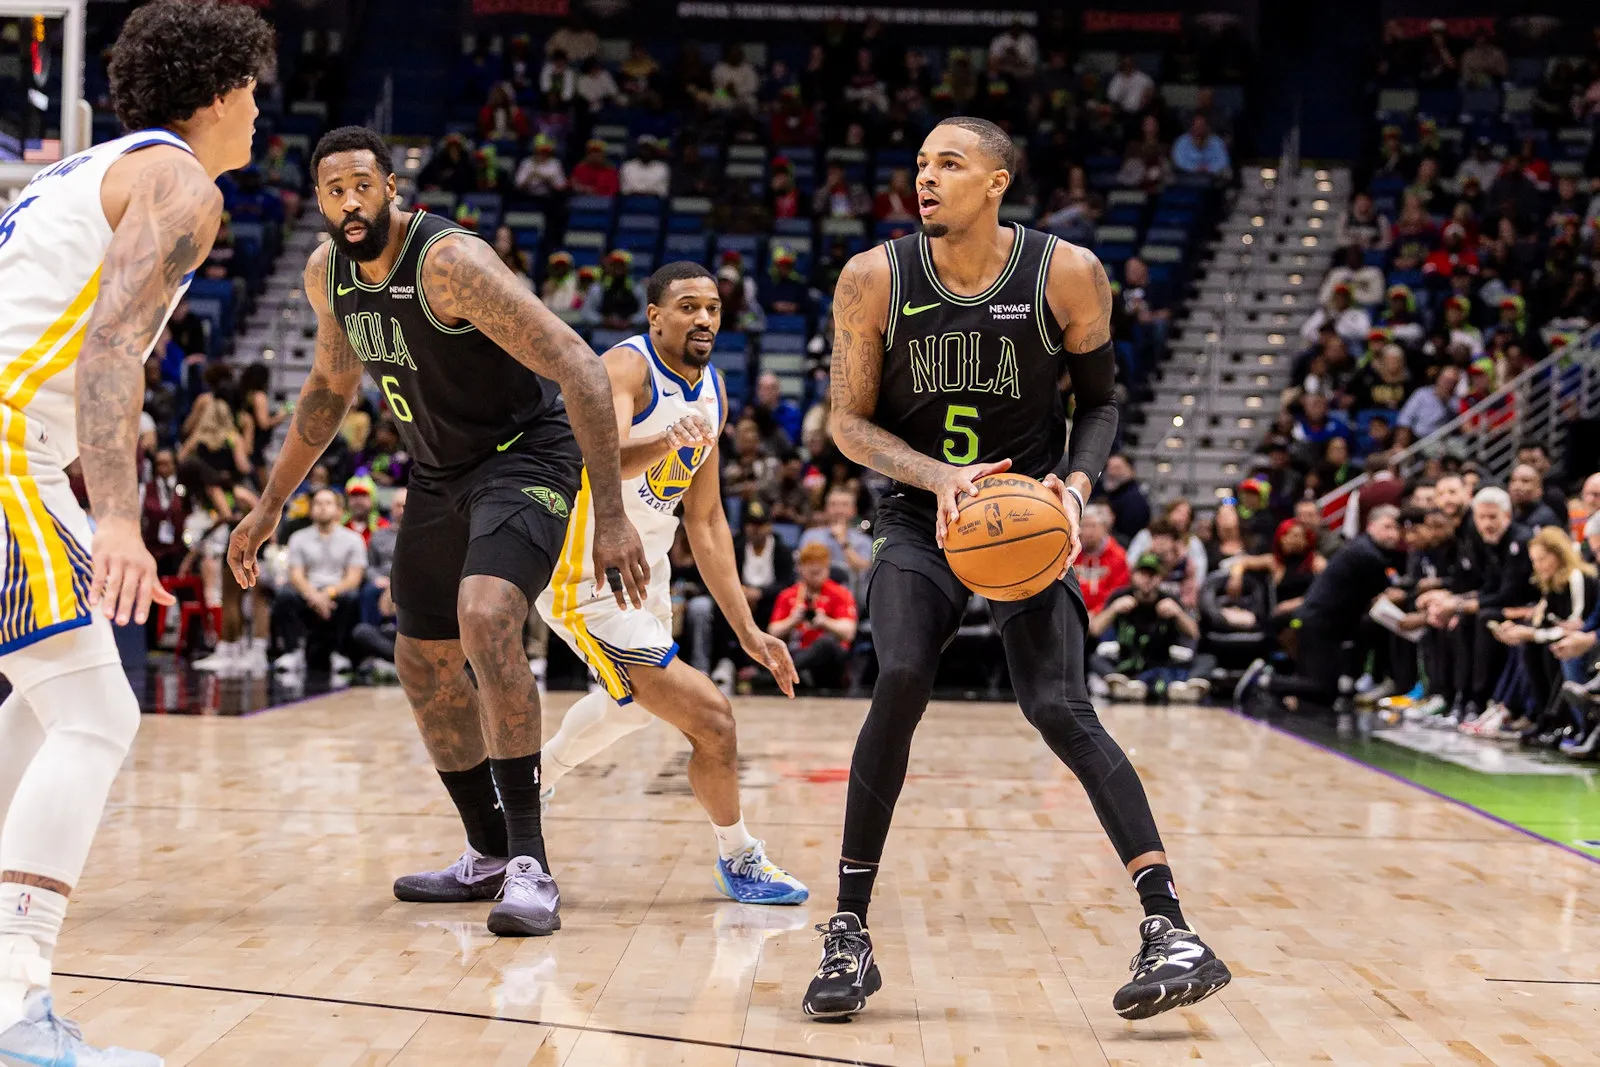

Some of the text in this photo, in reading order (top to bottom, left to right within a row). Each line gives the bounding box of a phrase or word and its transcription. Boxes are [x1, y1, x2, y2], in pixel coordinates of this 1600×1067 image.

[389, 286, 415, 294] NEWAGE
[989, 303, 1031, 313] NEWAGE
[344, 311, 418, 371] NOLA
[909, 331, 1021, 399] NOLA
[381, 375, 413, 423] 6
[943, 404, 980, 465] 5
